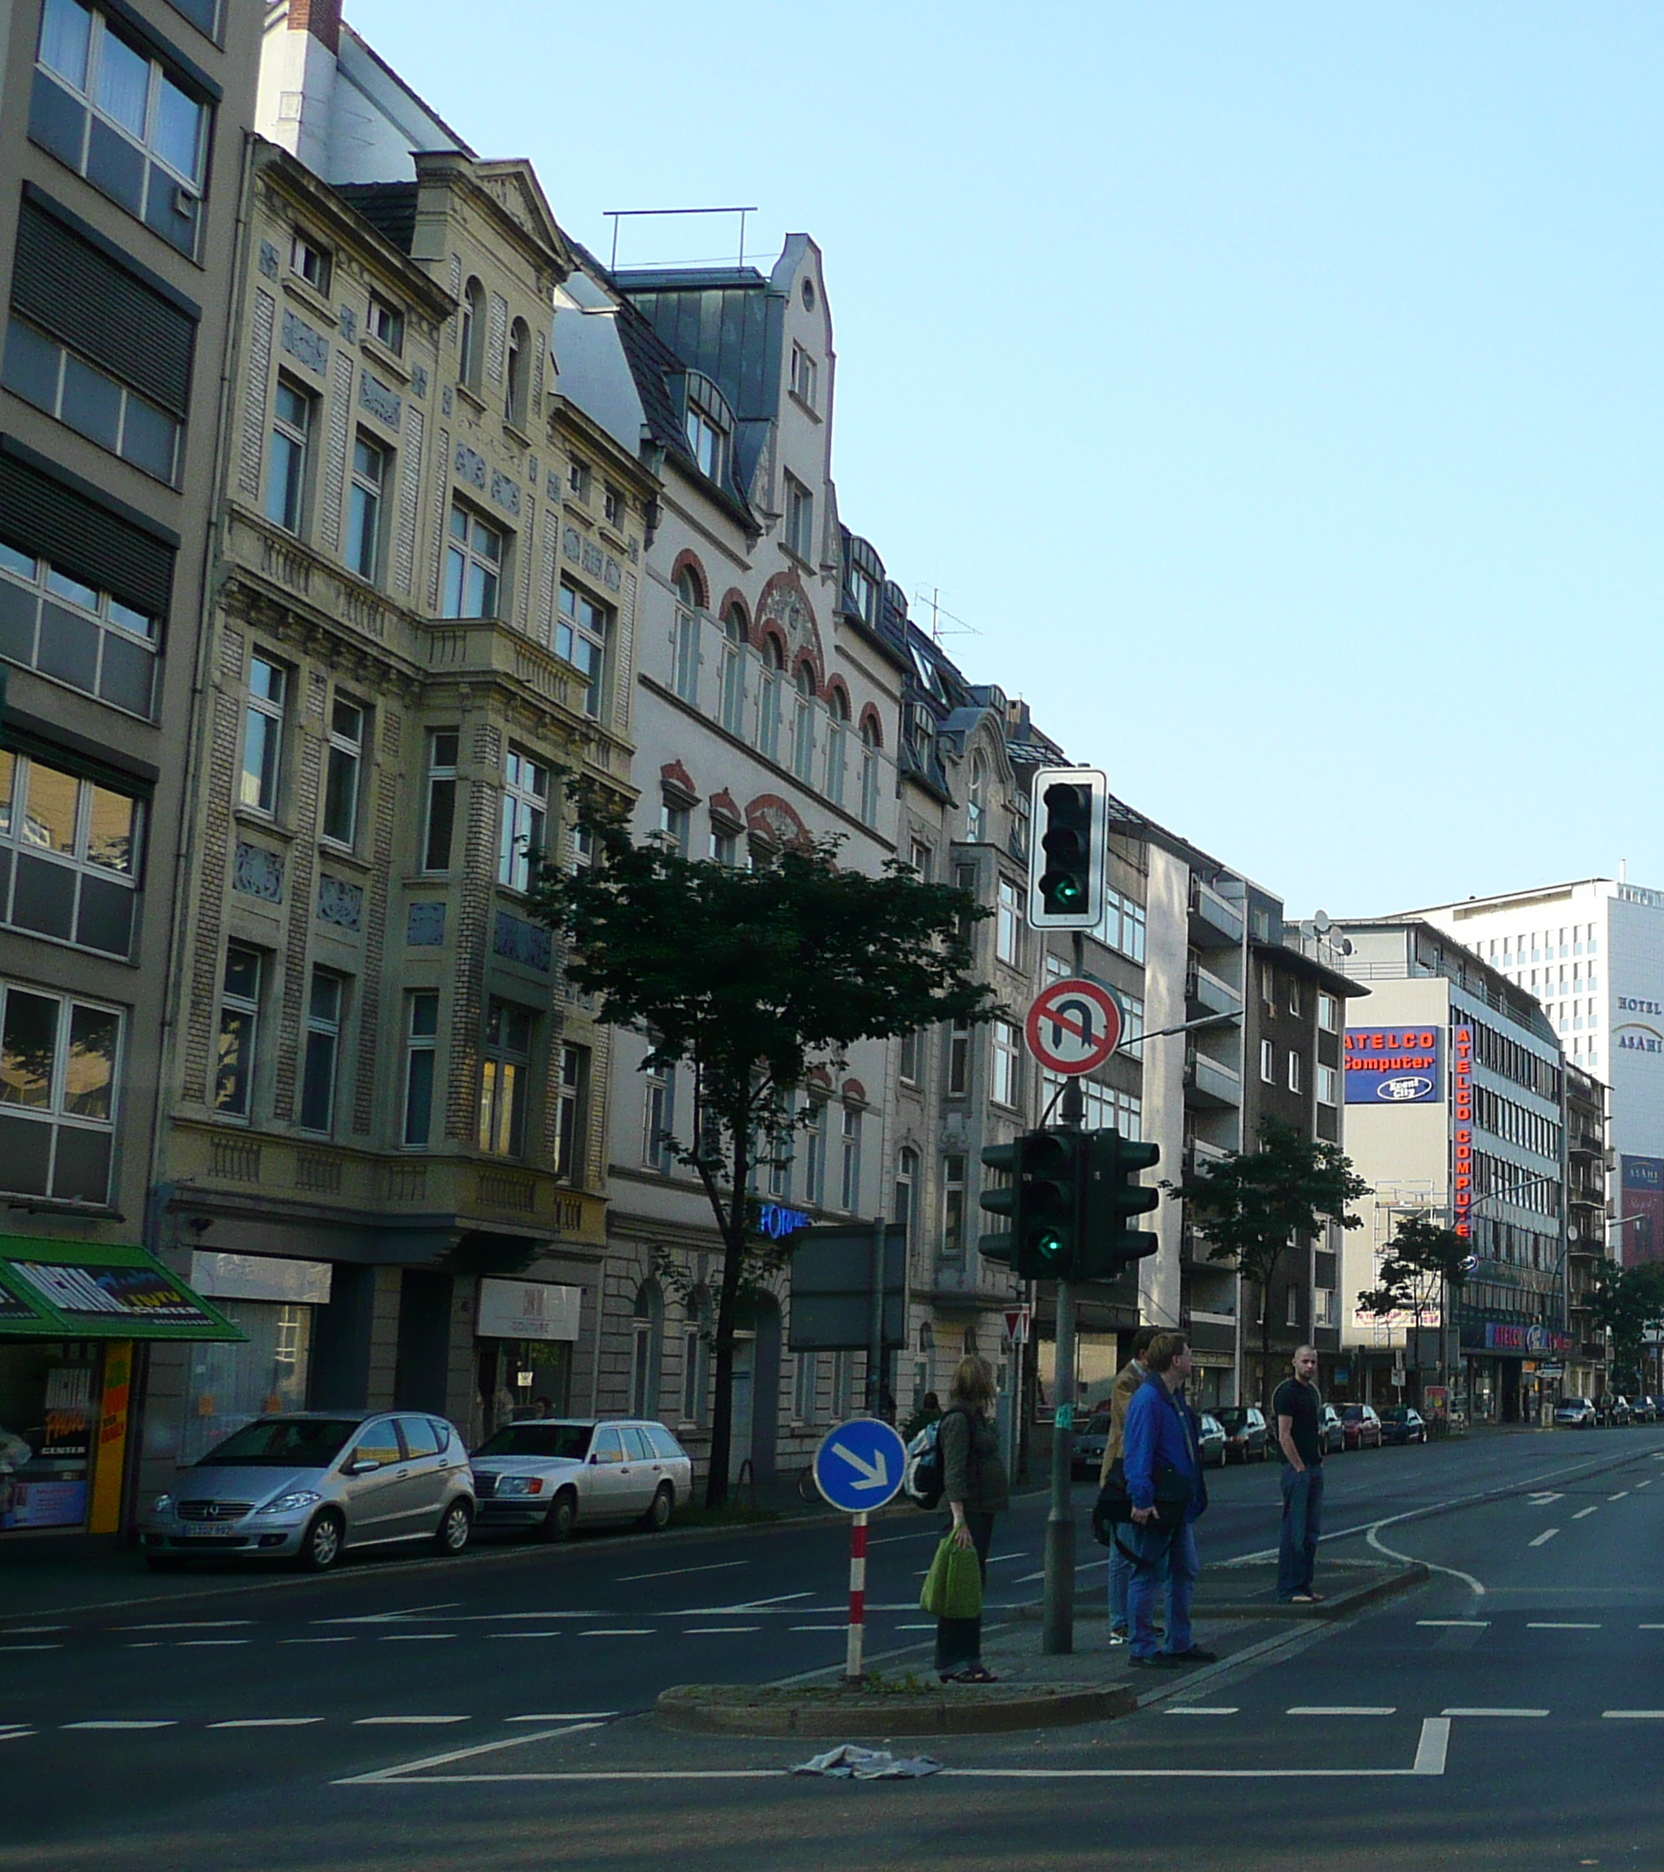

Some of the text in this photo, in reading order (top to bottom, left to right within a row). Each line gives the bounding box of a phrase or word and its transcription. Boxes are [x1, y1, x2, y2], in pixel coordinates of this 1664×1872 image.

[1618, 996, 1662, 1015] HOTEL
[1344, 1032, 1435, 1049] ATELCO
[1618, 1035, 1663, 1053] ASAHI
[1344, 1056, 1434, 1072] Computer
[1456, 1030, 1471, 1240] ATELCO COMPUTE
